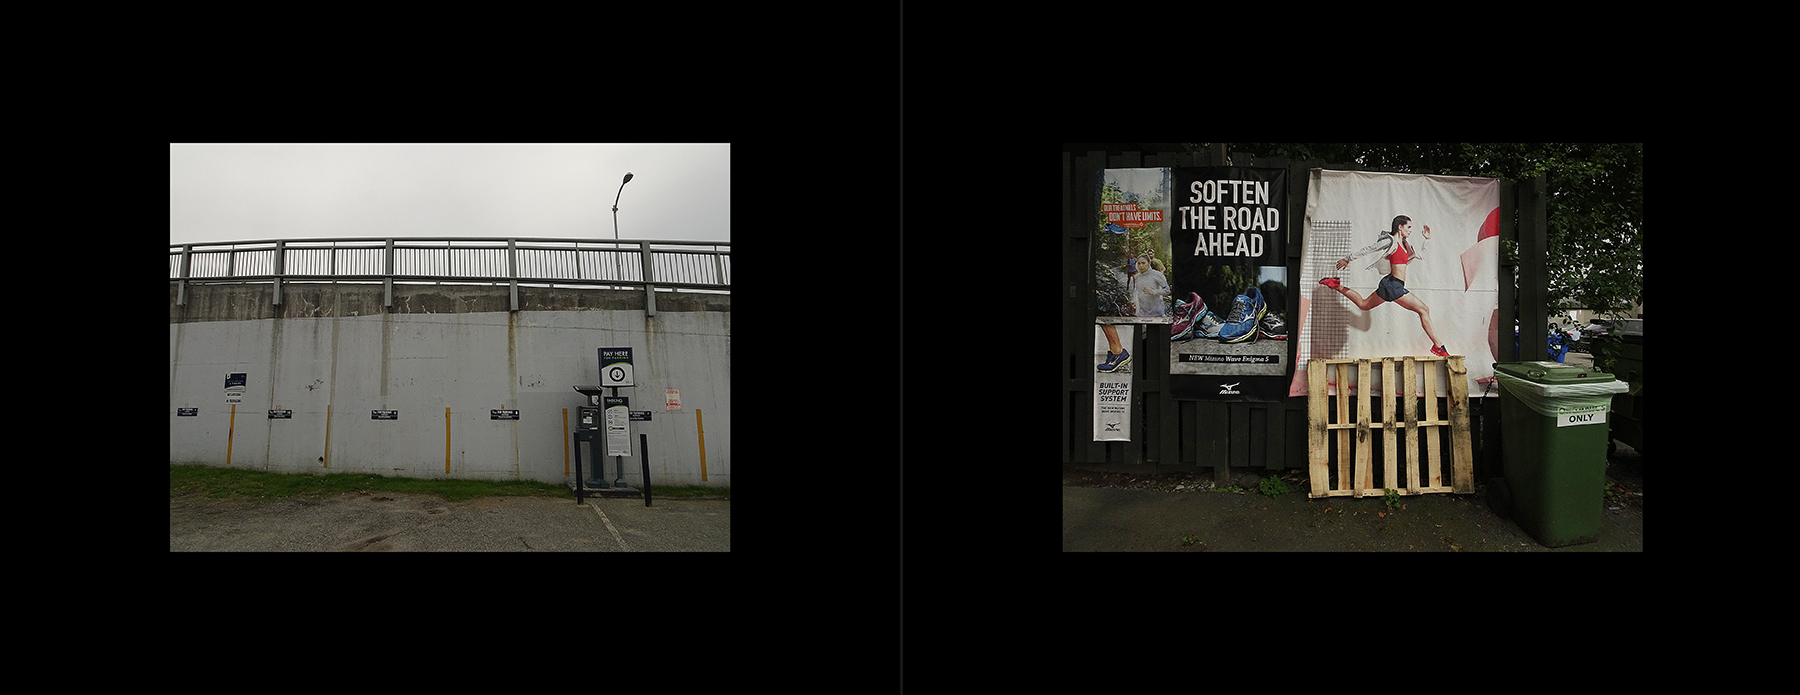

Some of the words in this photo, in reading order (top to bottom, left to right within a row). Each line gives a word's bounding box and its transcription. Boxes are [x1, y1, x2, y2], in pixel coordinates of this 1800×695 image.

[1189, 179, 1269, 205] SOFTEN
[1103, 204, 1112, 212] OUR
[1109, 212, 1125, 222] DON'T
[1126, 212, 1141, 221] HAVE
[1142, 211, 1162, 221] LIMITS.
[1179, 206, 1216, 230] THE
[1223, 206, 1280, 231] ROAD
[1194, 232, 1264, 257] AHEAD
[1242, 356, 1264, 364] Enigma
[1569, 414, 1594, 423] ONLY
